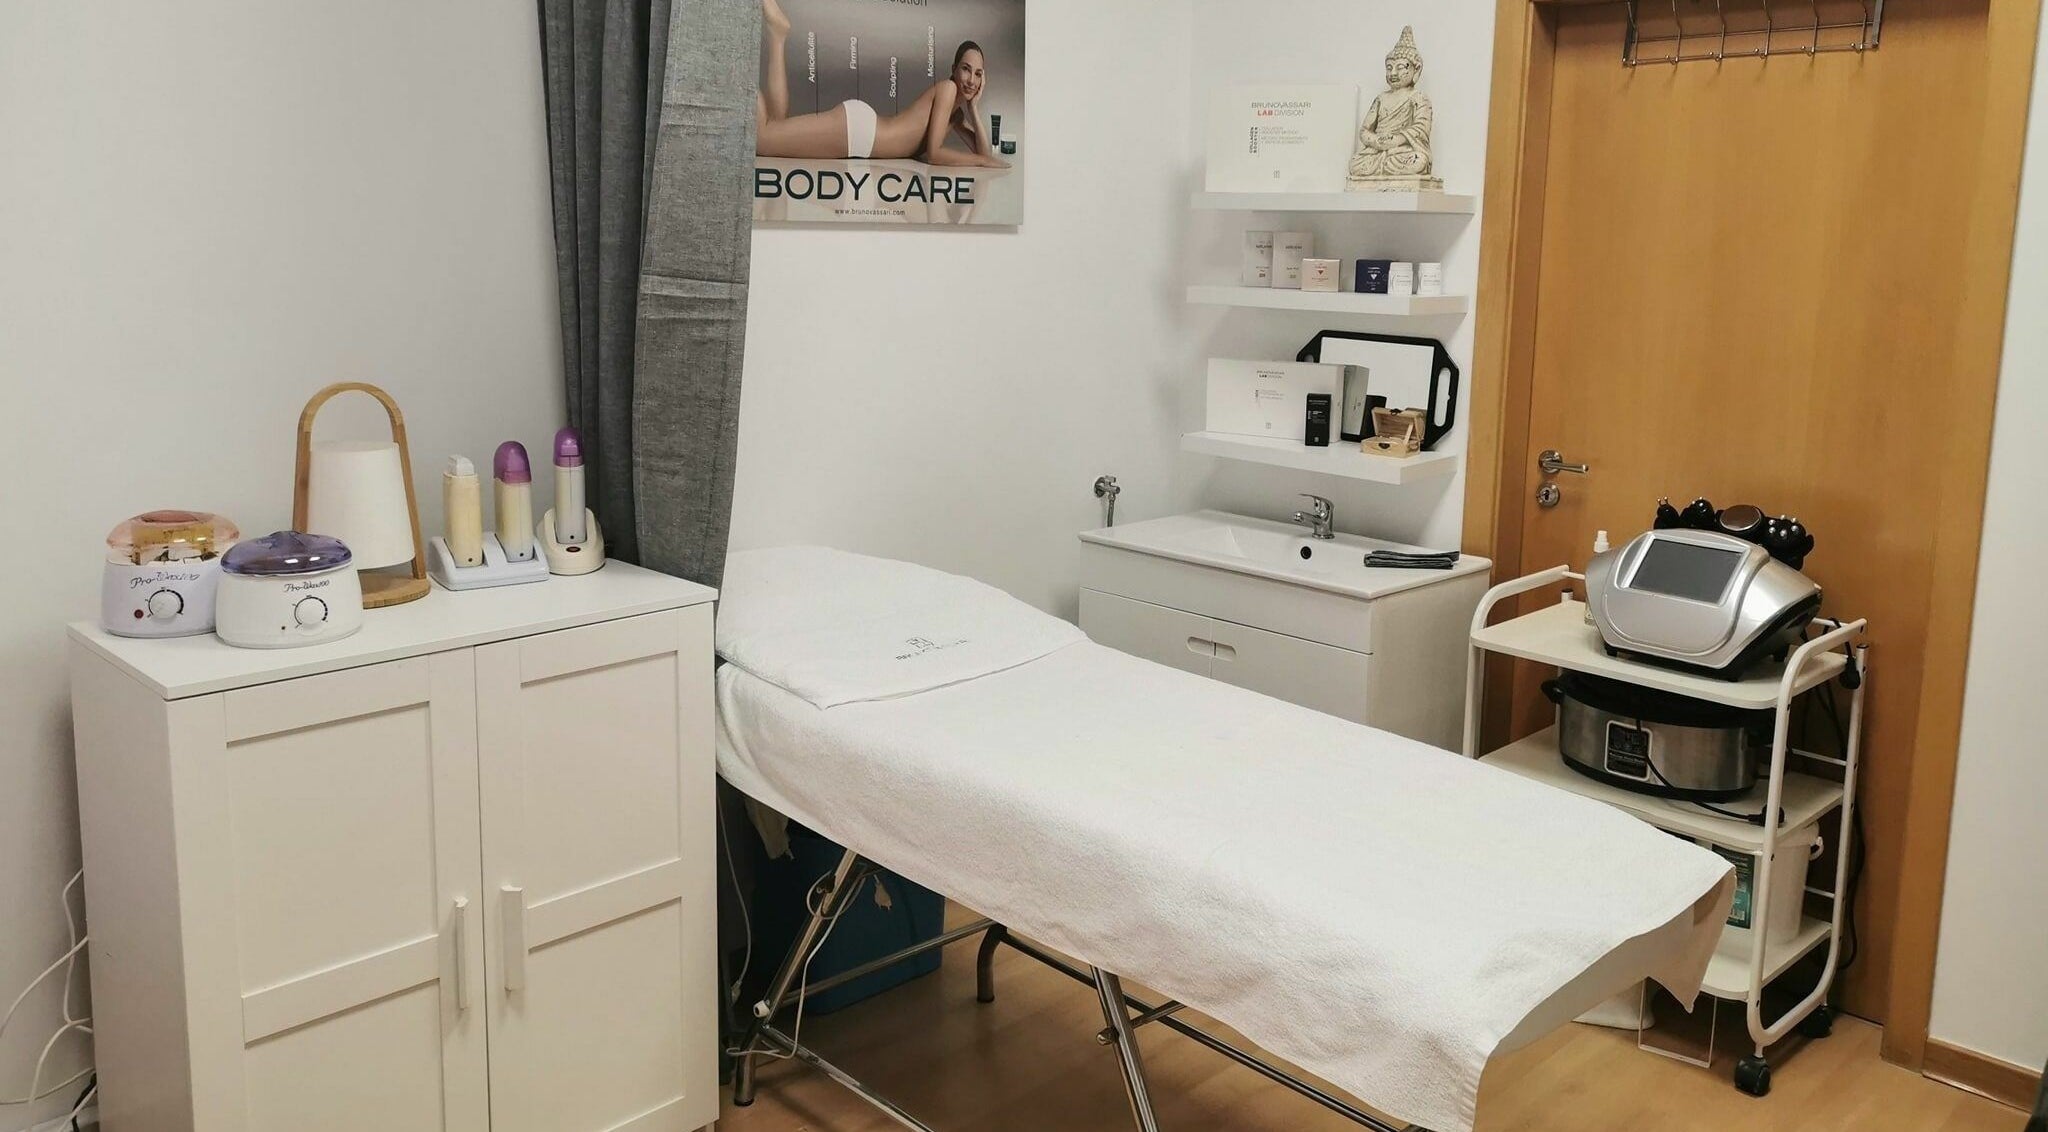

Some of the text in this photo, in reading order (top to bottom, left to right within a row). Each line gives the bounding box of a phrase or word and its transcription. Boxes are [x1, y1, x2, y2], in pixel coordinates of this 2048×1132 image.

[849, 36, 857, 70] Firming
[889, 56, 897, 98] Sculpting
[754, 167, 975, 204] BODY CARE
